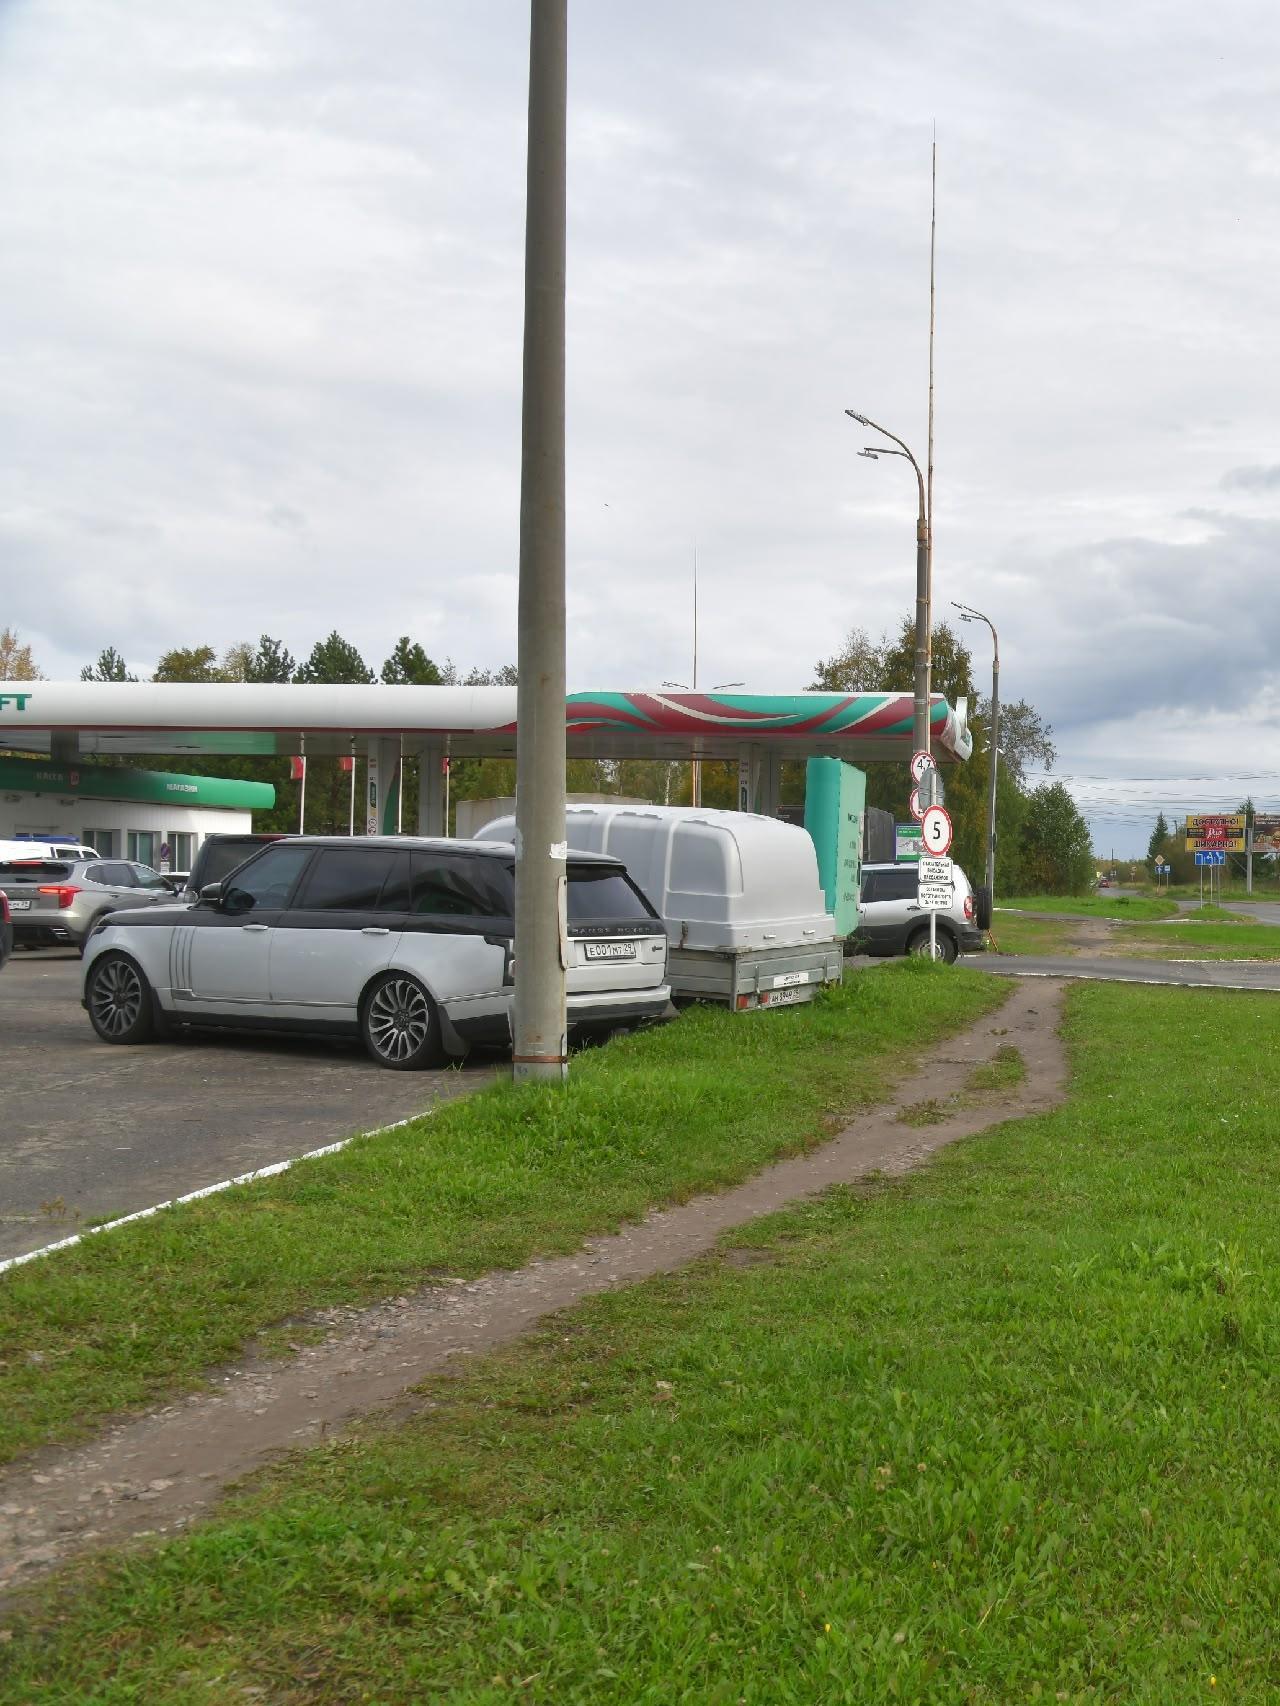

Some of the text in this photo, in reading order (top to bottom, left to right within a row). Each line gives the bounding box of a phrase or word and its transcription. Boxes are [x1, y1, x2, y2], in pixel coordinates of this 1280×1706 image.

[166, 783, 198, 793] МАГАЗИН
[1193, 818, 1239, 826] ДОСТУПНО!
[933, 821, 941, 839] 5
[1194, 840, 1237, 848] ШИКАРНО!
